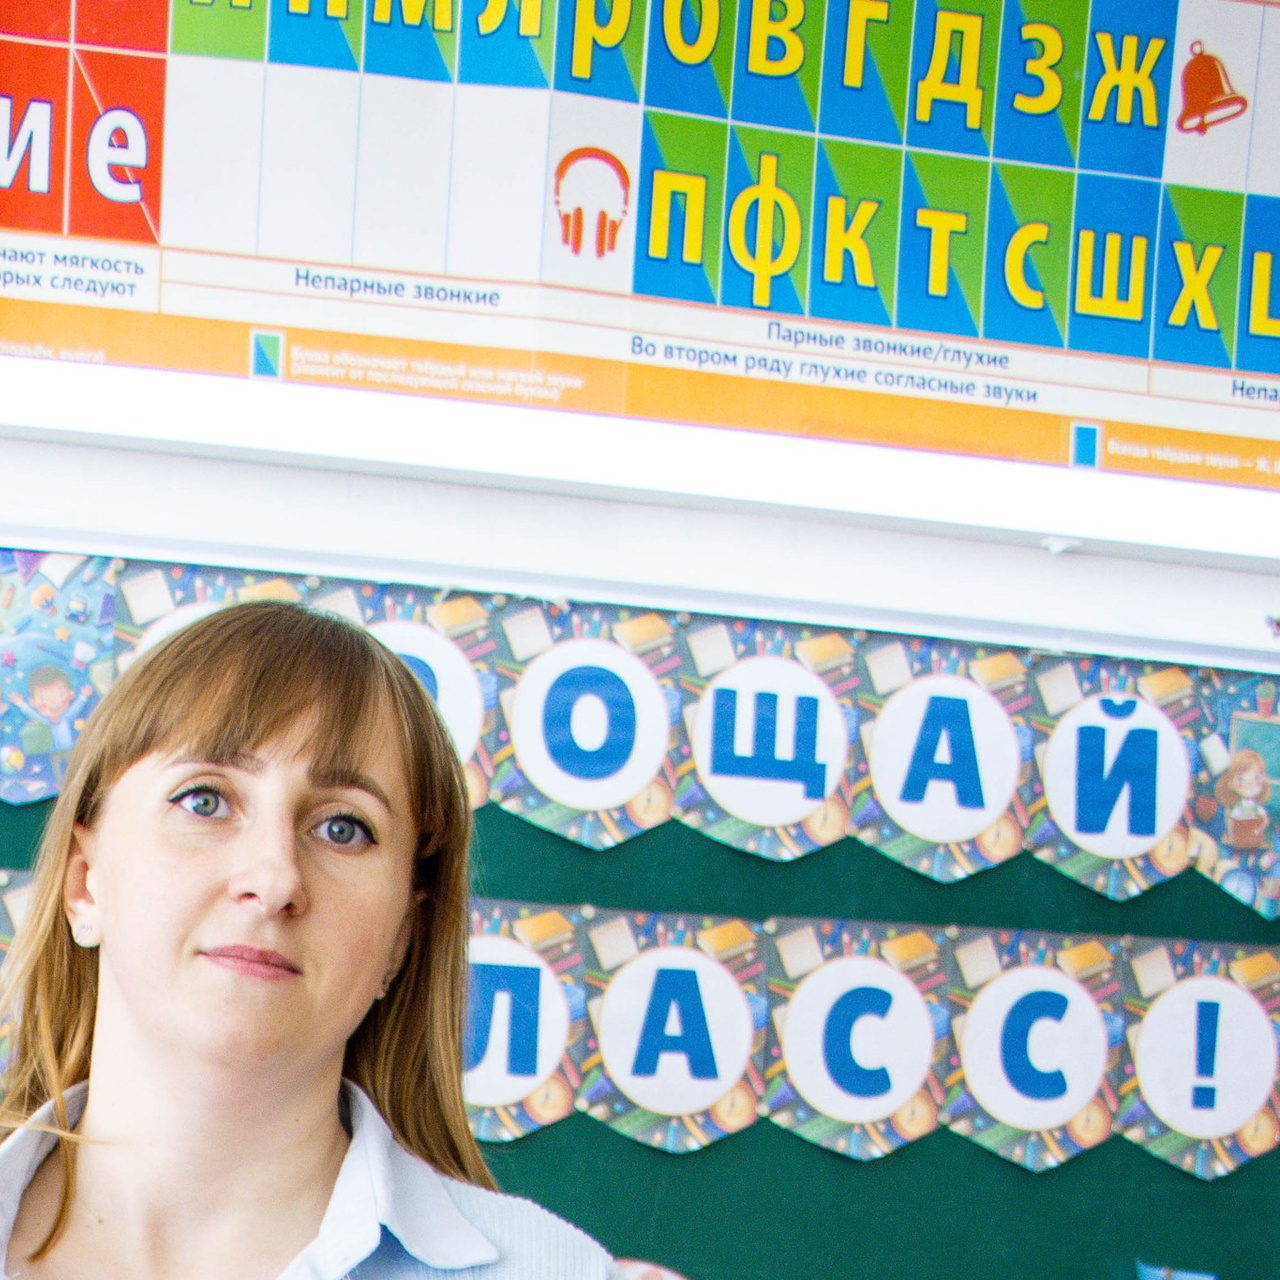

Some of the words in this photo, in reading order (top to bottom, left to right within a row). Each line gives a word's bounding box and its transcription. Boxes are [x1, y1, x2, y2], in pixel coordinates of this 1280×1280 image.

[53, 252, 145, 276] мягкость
[49, 275, 137, 299] следуют
[295, 267, 406, 300] Непарные
[412, 283, 501, 308] звонкие
[767, 321, 846, 350] Парные
[852, 336, 1010, 371] звонкие/глухие
[631, 335, 657, 358] Во
[663, 343, 738, 370] втором
[744, 353, 792, 379] ряду
[799, 361, 868, 385] глухие
[874, 369, 977, 398] согласные
[983, 384, 1038, 408] звуки
[398, 653, 1160, 837] ОЩАЙ
